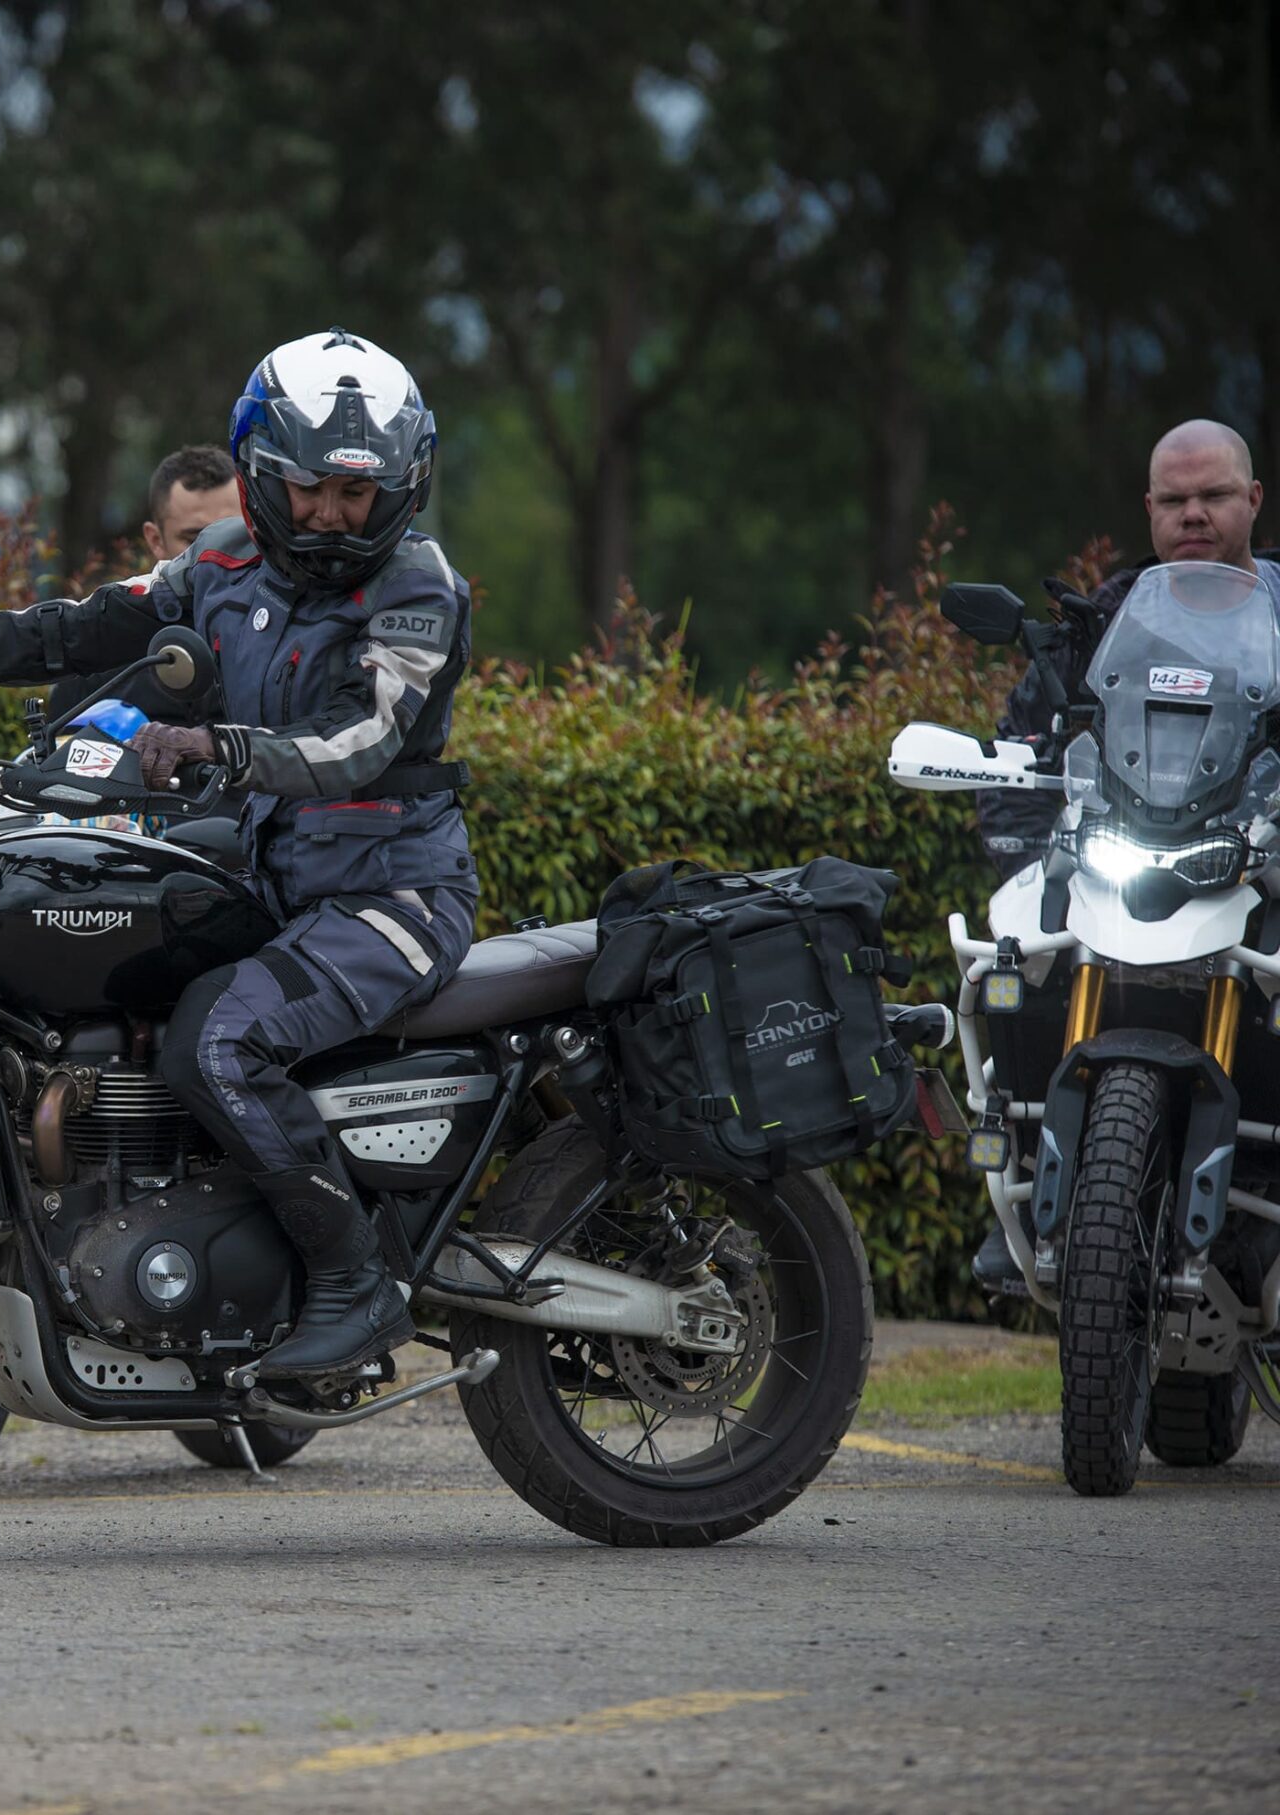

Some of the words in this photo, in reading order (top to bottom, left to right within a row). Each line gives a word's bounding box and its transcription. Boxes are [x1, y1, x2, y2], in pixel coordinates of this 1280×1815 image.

[397, 615, 437, 636] ADT
[1151, 673, 1180, 685] 144
[69, 748, 91, 765] 131
[919, 765, 1010, 783] Barkbusters
[31, 909, 132, 933] TRIUMPH
[745, 1009, 840, 1049] CANYON
[348, 1089, 428, 1108] SCRAMBLER
[430, 1086, 458, 1099] 1200
[310, 1174, 350, 1201] BIKERLAND
[724, 1244, 754, 1265] brembo
[148, 1272, 187, 1283] TRIUMPH
